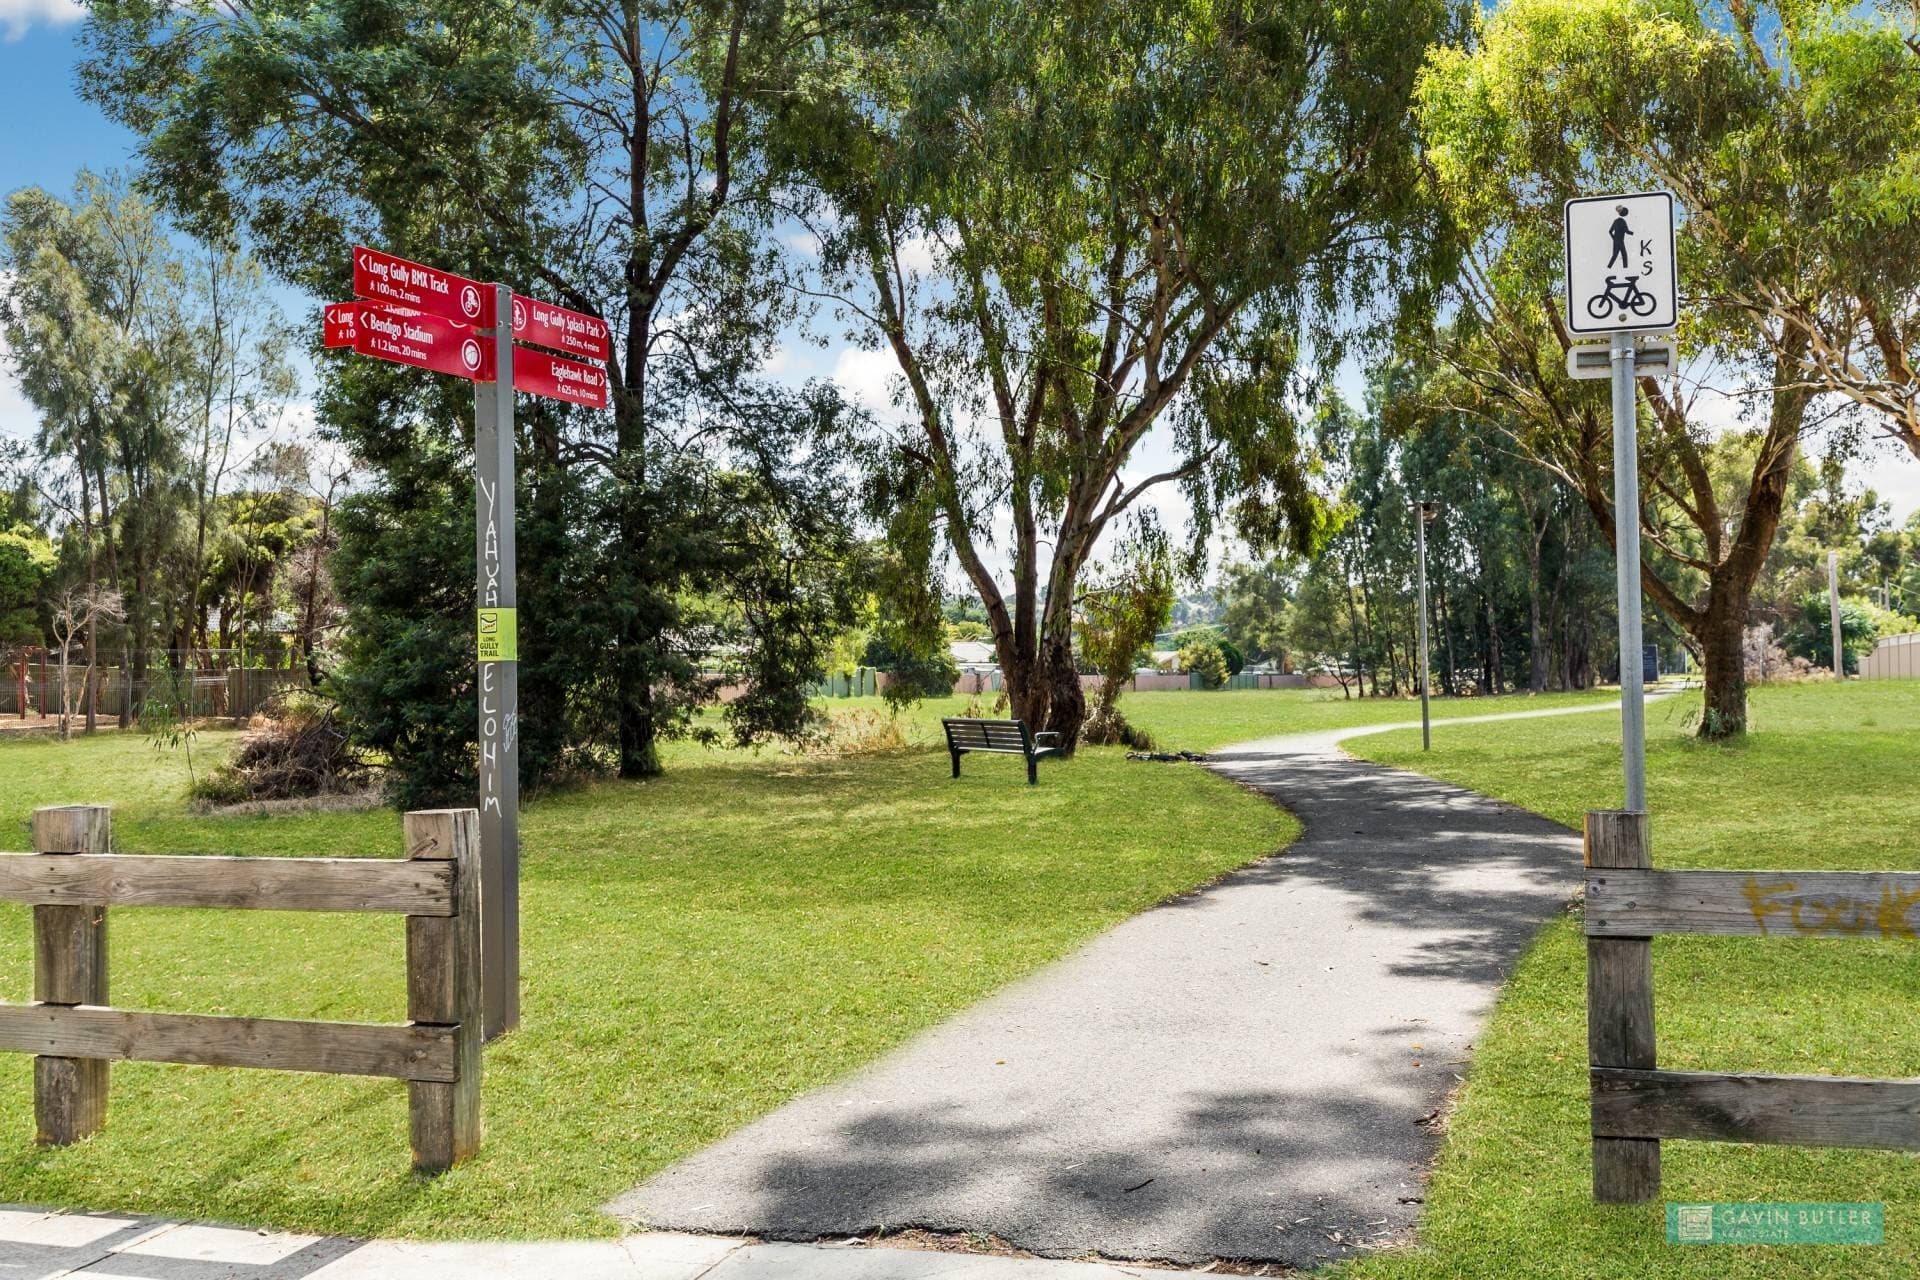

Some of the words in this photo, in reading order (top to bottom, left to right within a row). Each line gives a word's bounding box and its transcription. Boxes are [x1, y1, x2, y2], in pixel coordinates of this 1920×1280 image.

[1639, 239, 1652, 257] K
[369, 256, 389, 282] Long
[390, 263, 410, 288] Gully
[412, 270, 428, 288] BMX
[430, 274, 448, 294] Track
[1641, 260, 1653, 276] S
[377, 282, 389, 294] 100
[400, 289, 404, 299] 2
[405, 292, 420, 303] mins
[338, 309, 354, 327] Long
[534, 306, 548, 328] Long
[550, 311, 565, 331] Gully
[566, 316, 585, 334] Splash
[586, 322, 600, 338] Park
[371, 314, 402, 340] Bendigo
[404, 322, 434, 344] Stadium
[378, 339, 388, 350] 1.2
[402, 345, 410, 356] 20
[411, 349, 427, 360] mins
[587, 344, 600, 352] mins
[552, 362, 582, 382] Eaglehawk
[584, 370, 598, 386] Road
[587, 392, 598, 400] mins
[483, 662, 502, 818] ELOHIM
